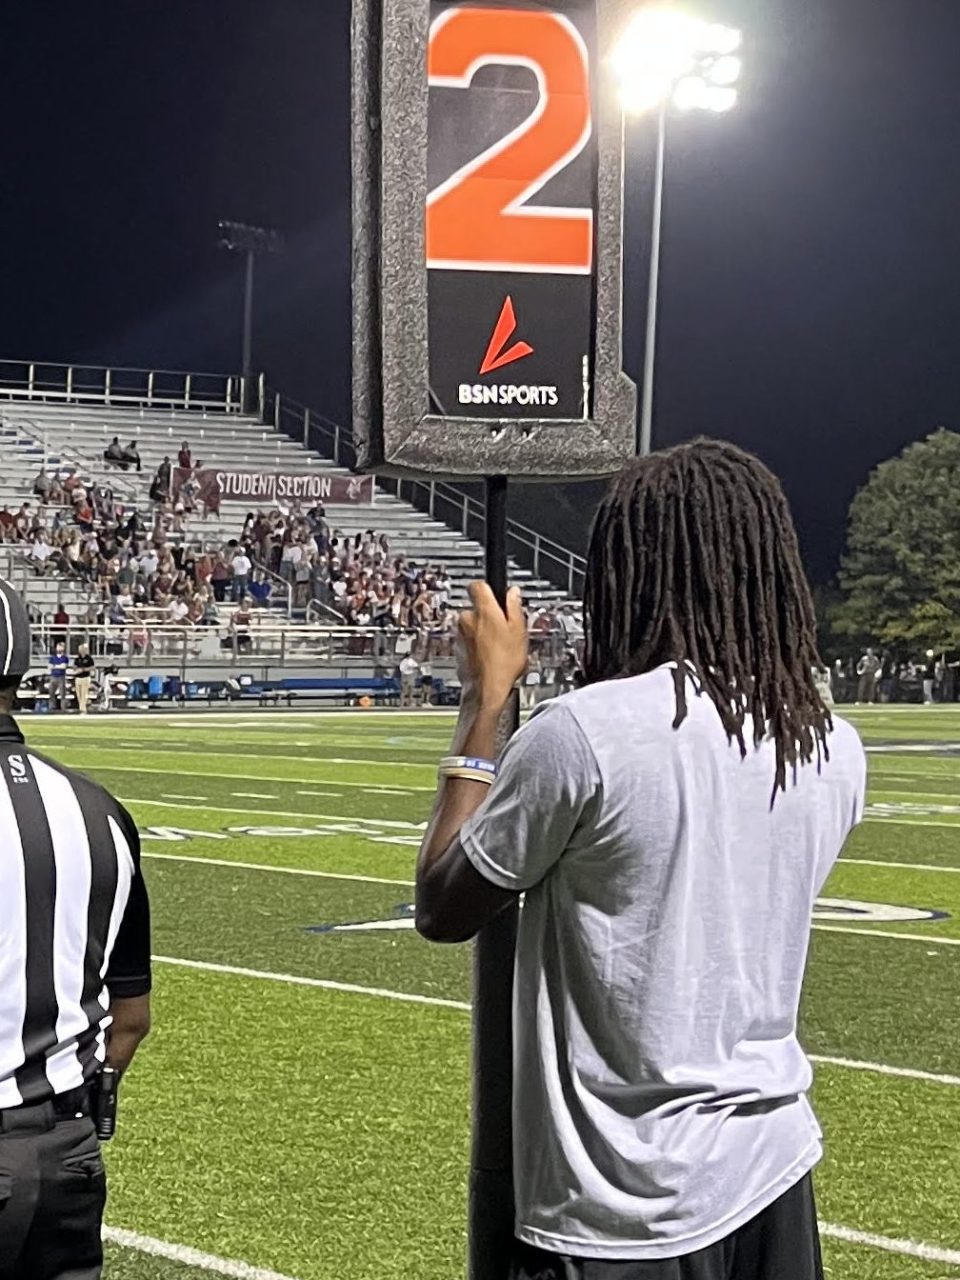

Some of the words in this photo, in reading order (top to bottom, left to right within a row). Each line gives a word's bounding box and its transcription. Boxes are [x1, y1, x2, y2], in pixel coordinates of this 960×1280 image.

[425, 7, 593, 275] 2
[216, 472, 275, 497] STUDENT
[277, 475, 332, 498] SECTION
[7, 754, 26, 777] S
